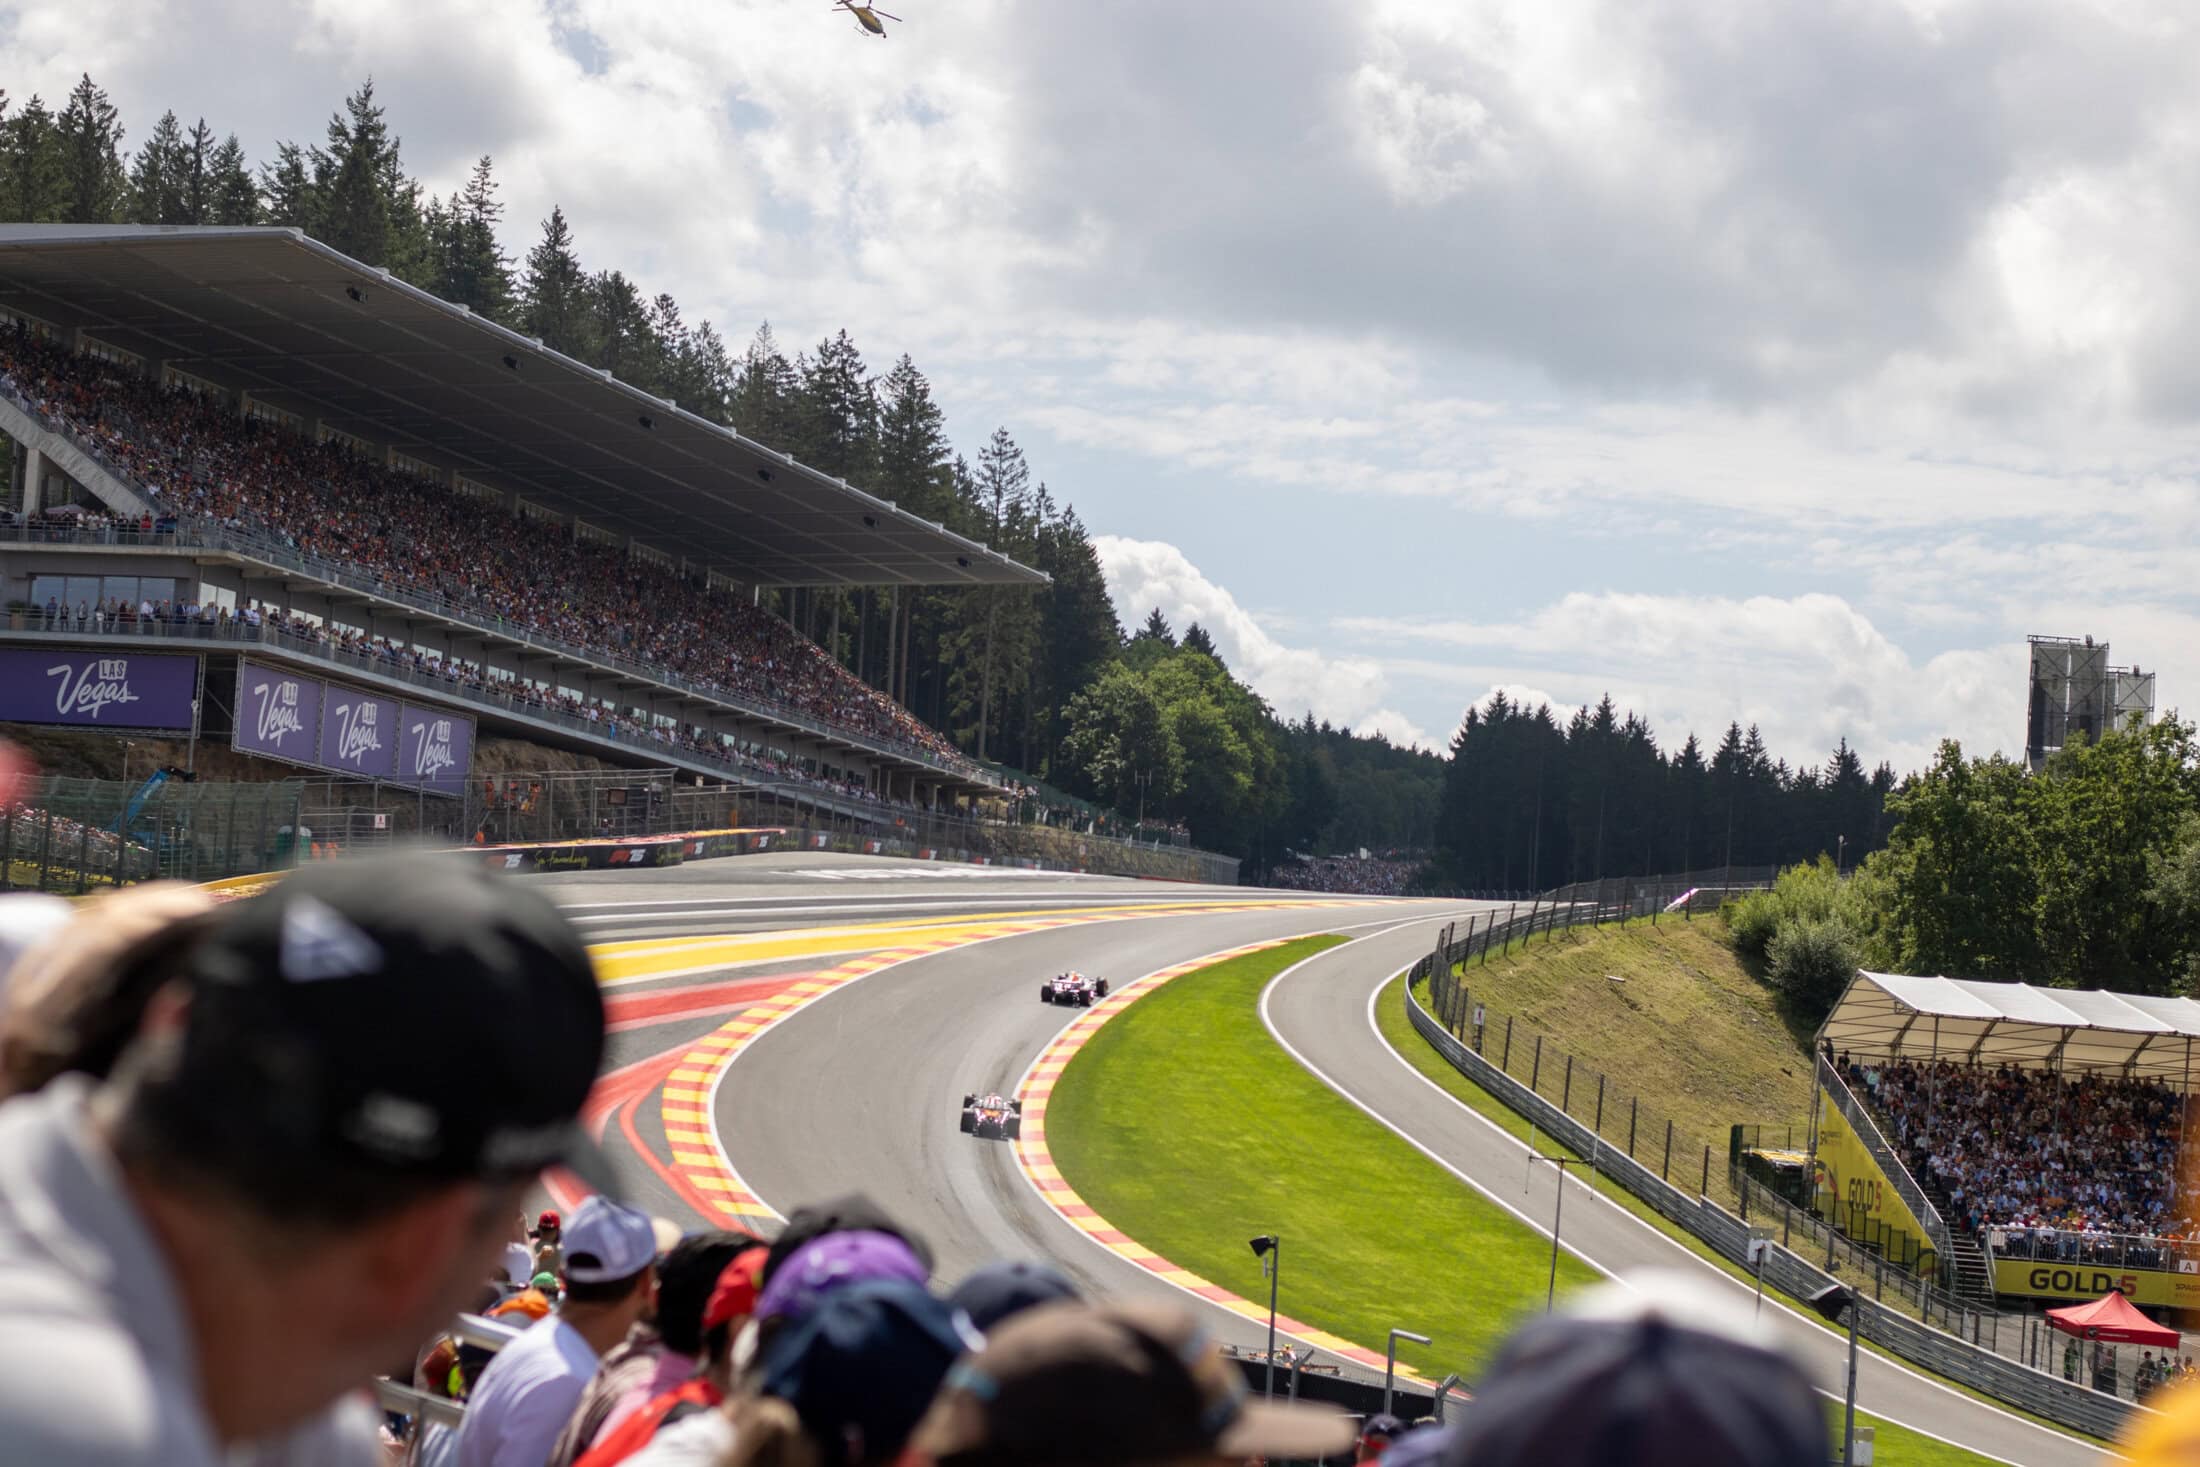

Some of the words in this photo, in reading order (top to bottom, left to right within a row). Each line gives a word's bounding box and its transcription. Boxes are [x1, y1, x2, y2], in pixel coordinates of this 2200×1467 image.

[47, 662, 140, 719] Vegas
[101, 661, 126, 679] LAS
[254, 683, 303, 748] Vegas
[336, 704, 382, 767] Vegas
[412, 722, 455, 782] Vegas
[1848, 1177, 1874, 1211] GOLD
[2029, 1268, 2112, 1295] GOLD
[2120, 1275, 2138, 1297] 5
[2183, 1261, 2193, 1272] A
